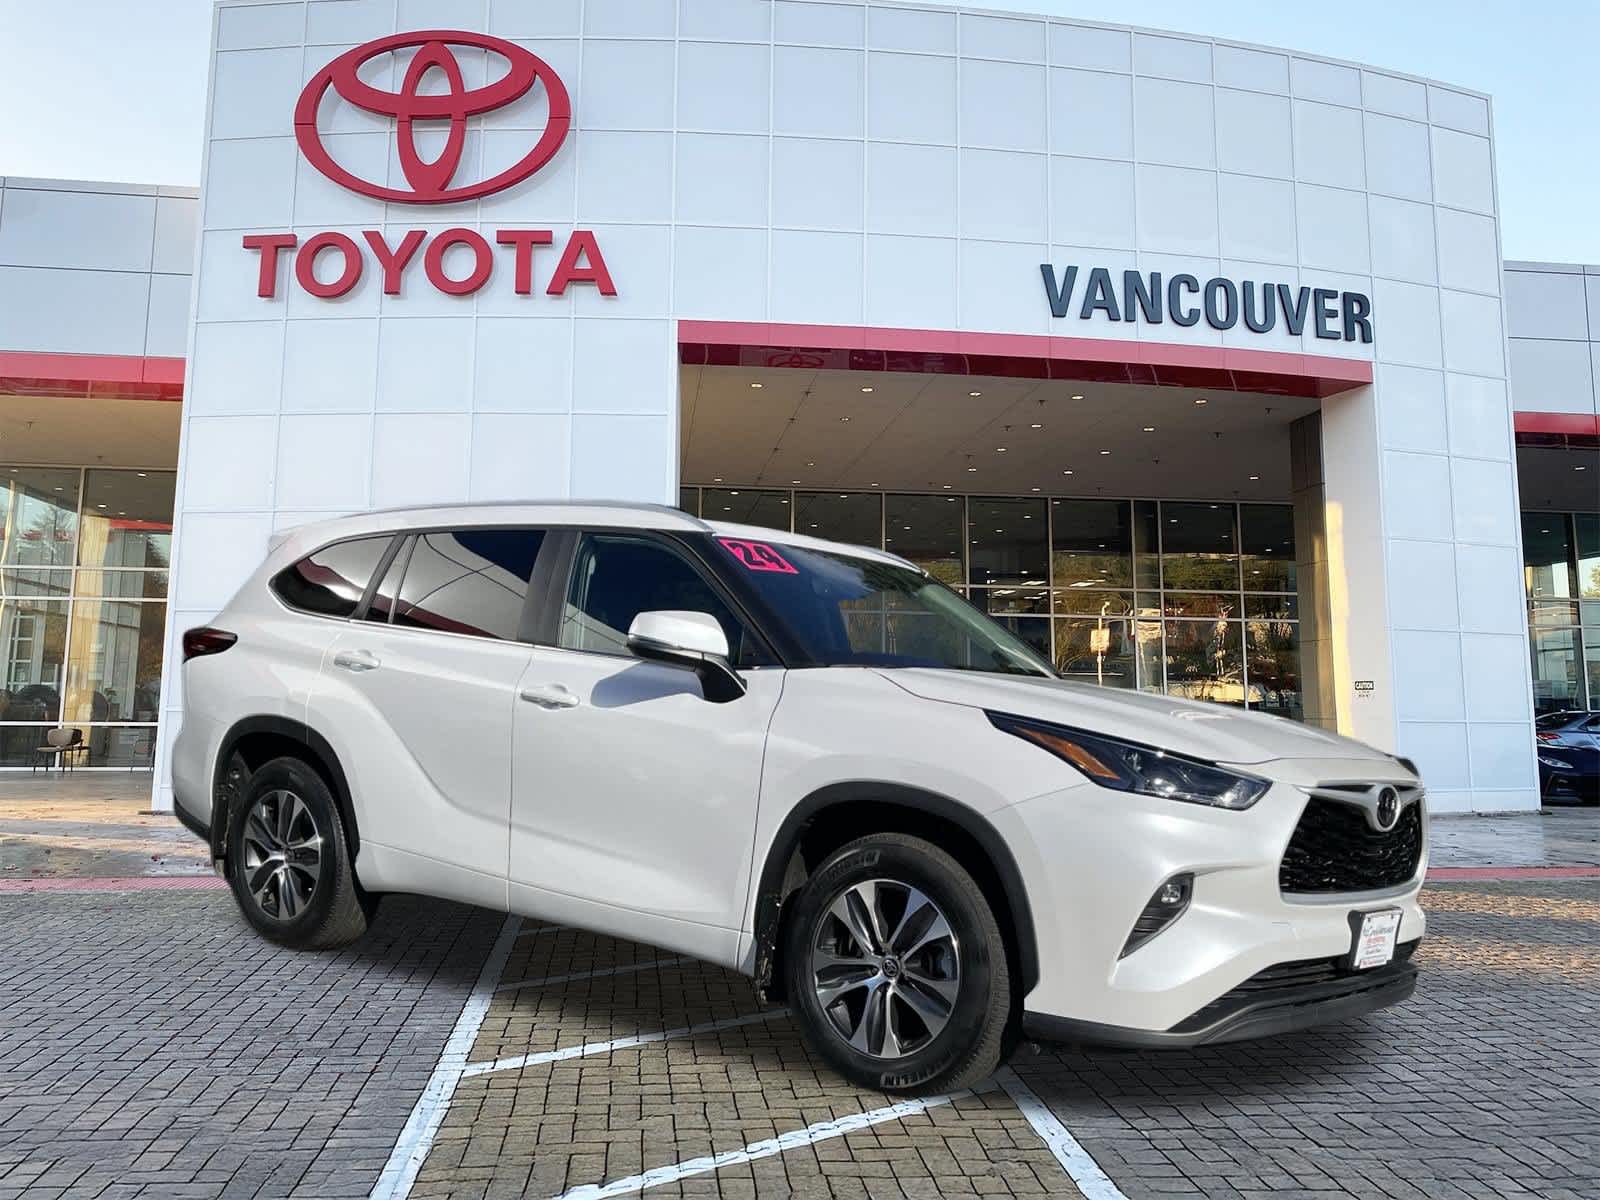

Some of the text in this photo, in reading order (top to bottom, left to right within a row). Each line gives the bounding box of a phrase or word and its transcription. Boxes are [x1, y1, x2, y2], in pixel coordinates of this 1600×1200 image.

[243, 228, 617, 298] TOYOTA
[1040, 264, 1373, 343] VANCOUVER
[727, 542, 786, 570] 24
